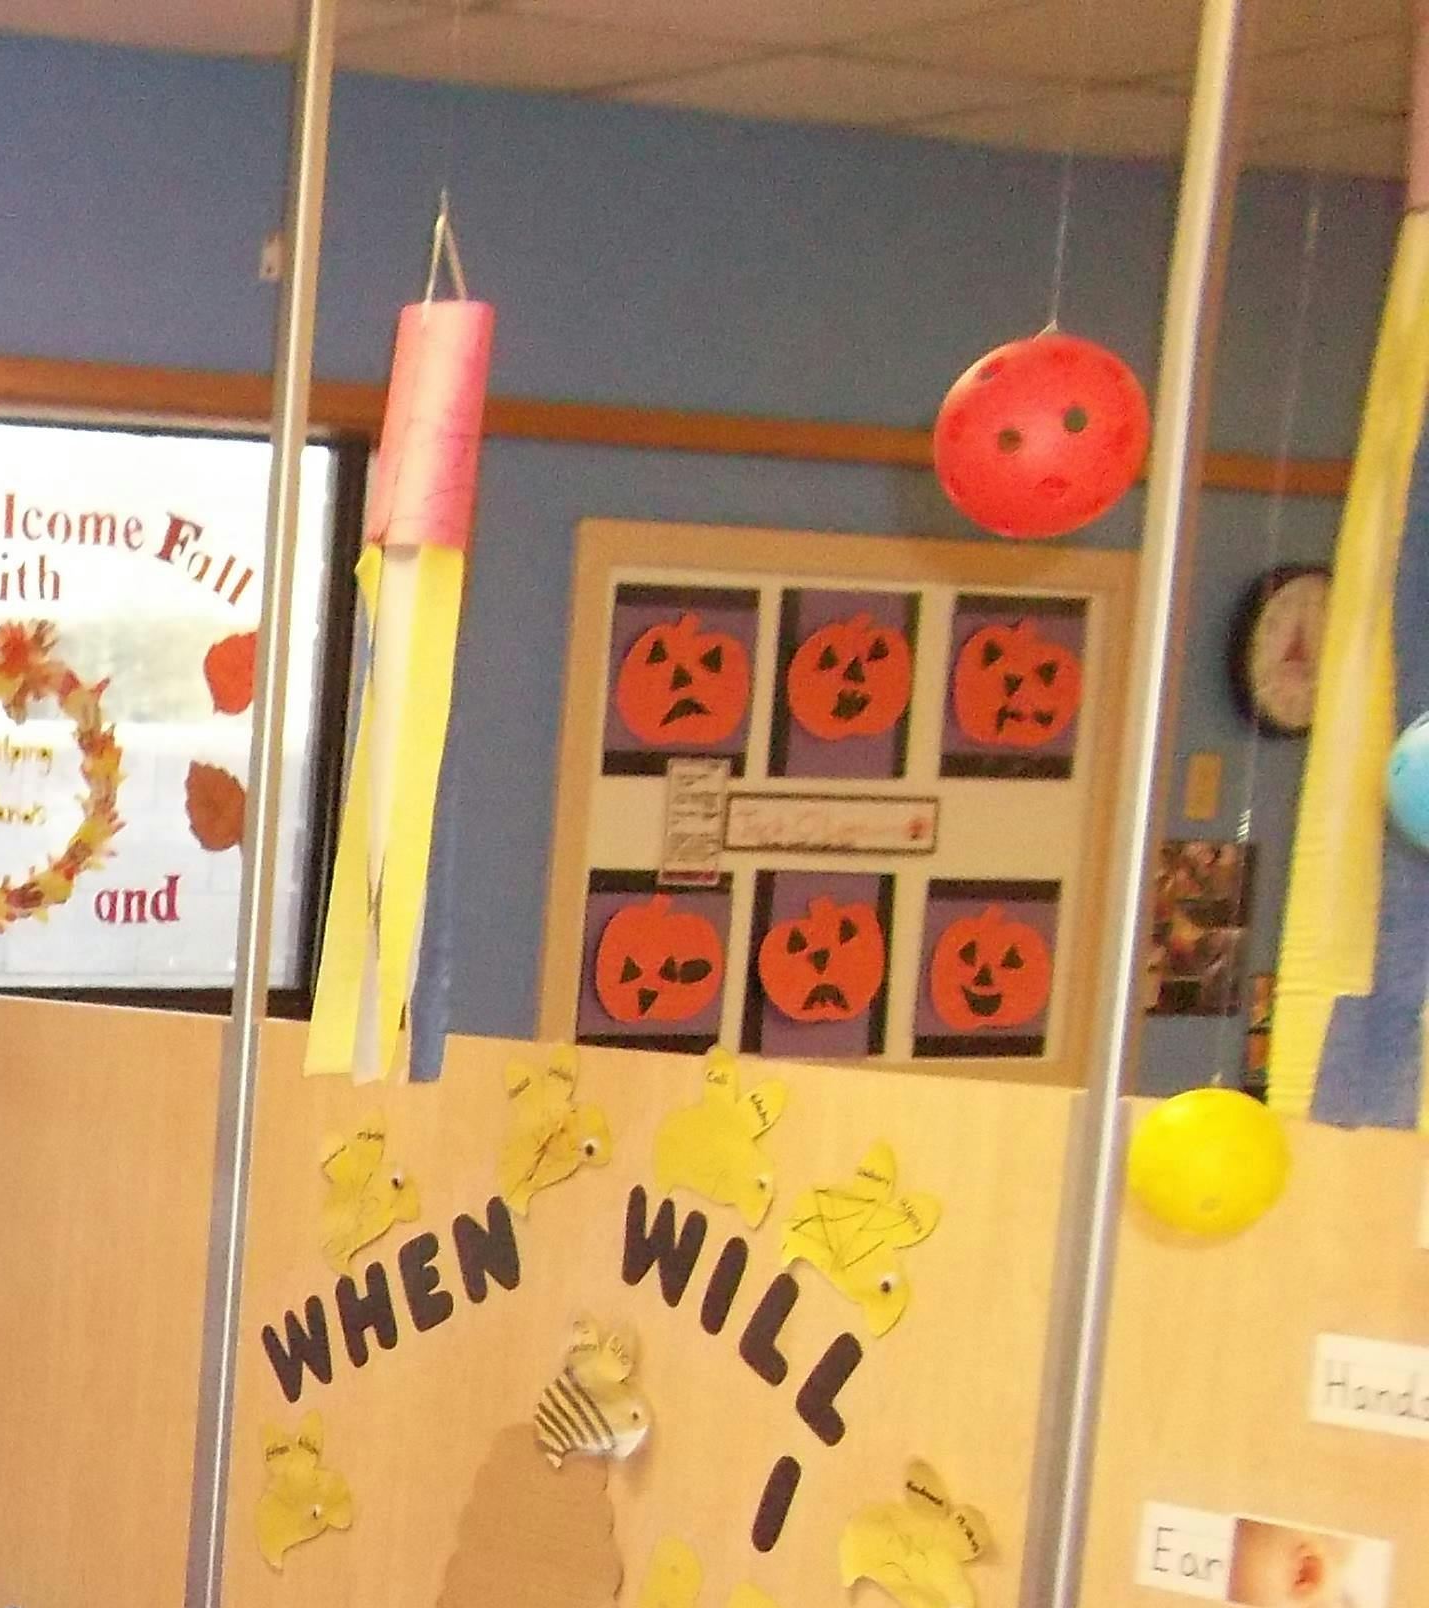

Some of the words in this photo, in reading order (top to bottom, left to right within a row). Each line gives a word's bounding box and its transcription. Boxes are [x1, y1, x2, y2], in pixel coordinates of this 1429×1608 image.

[154, 511, 254, 606] Fall
[94, 874, 181, 924] and
[262, 1197, 520, 1403] WHEN
[623, 1186, 862, 1446] WILL
[752, 1456, 801, 1552] I
[1152, 1527, 1222, 1581] Ear
